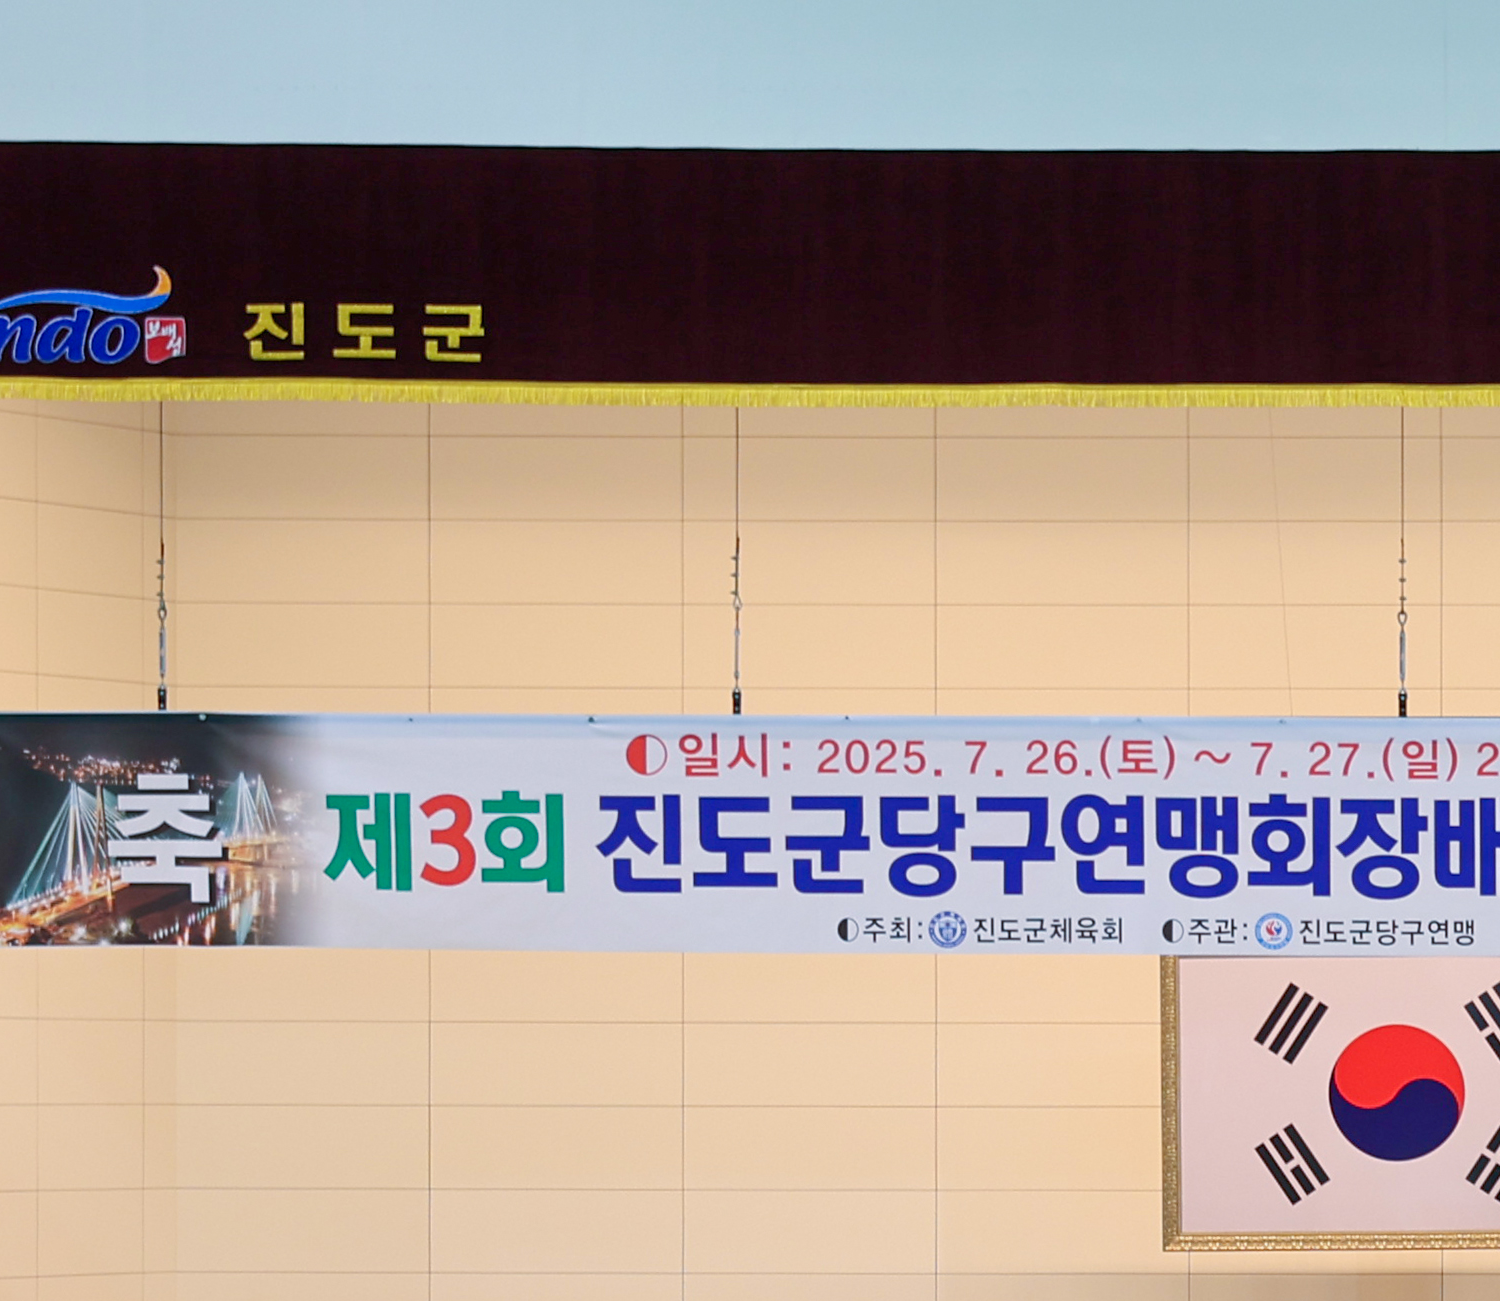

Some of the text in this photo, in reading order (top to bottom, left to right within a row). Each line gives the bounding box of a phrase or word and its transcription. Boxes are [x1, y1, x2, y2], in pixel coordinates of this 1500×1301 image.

[244, 302, 486, 363] 진도군
[678, 733, 791, 777] 일시:
[817, 740, 944, 777] 2025.
[964, 741, 1003, 777] 7.
[1025, 735, 1177, 778] 26.(토)
[1251, 742, 1288, 777] 7.
[1307, 735, 1458, 780] 27.(일)
[108, 772, 224, 905] 축
[322, 790, 565, 893] 제3회
[862, 915, 1125, 947] 주최: 진도군체육회
[1189, 915, 1477, 947] 주관: 진도군당구연맹
